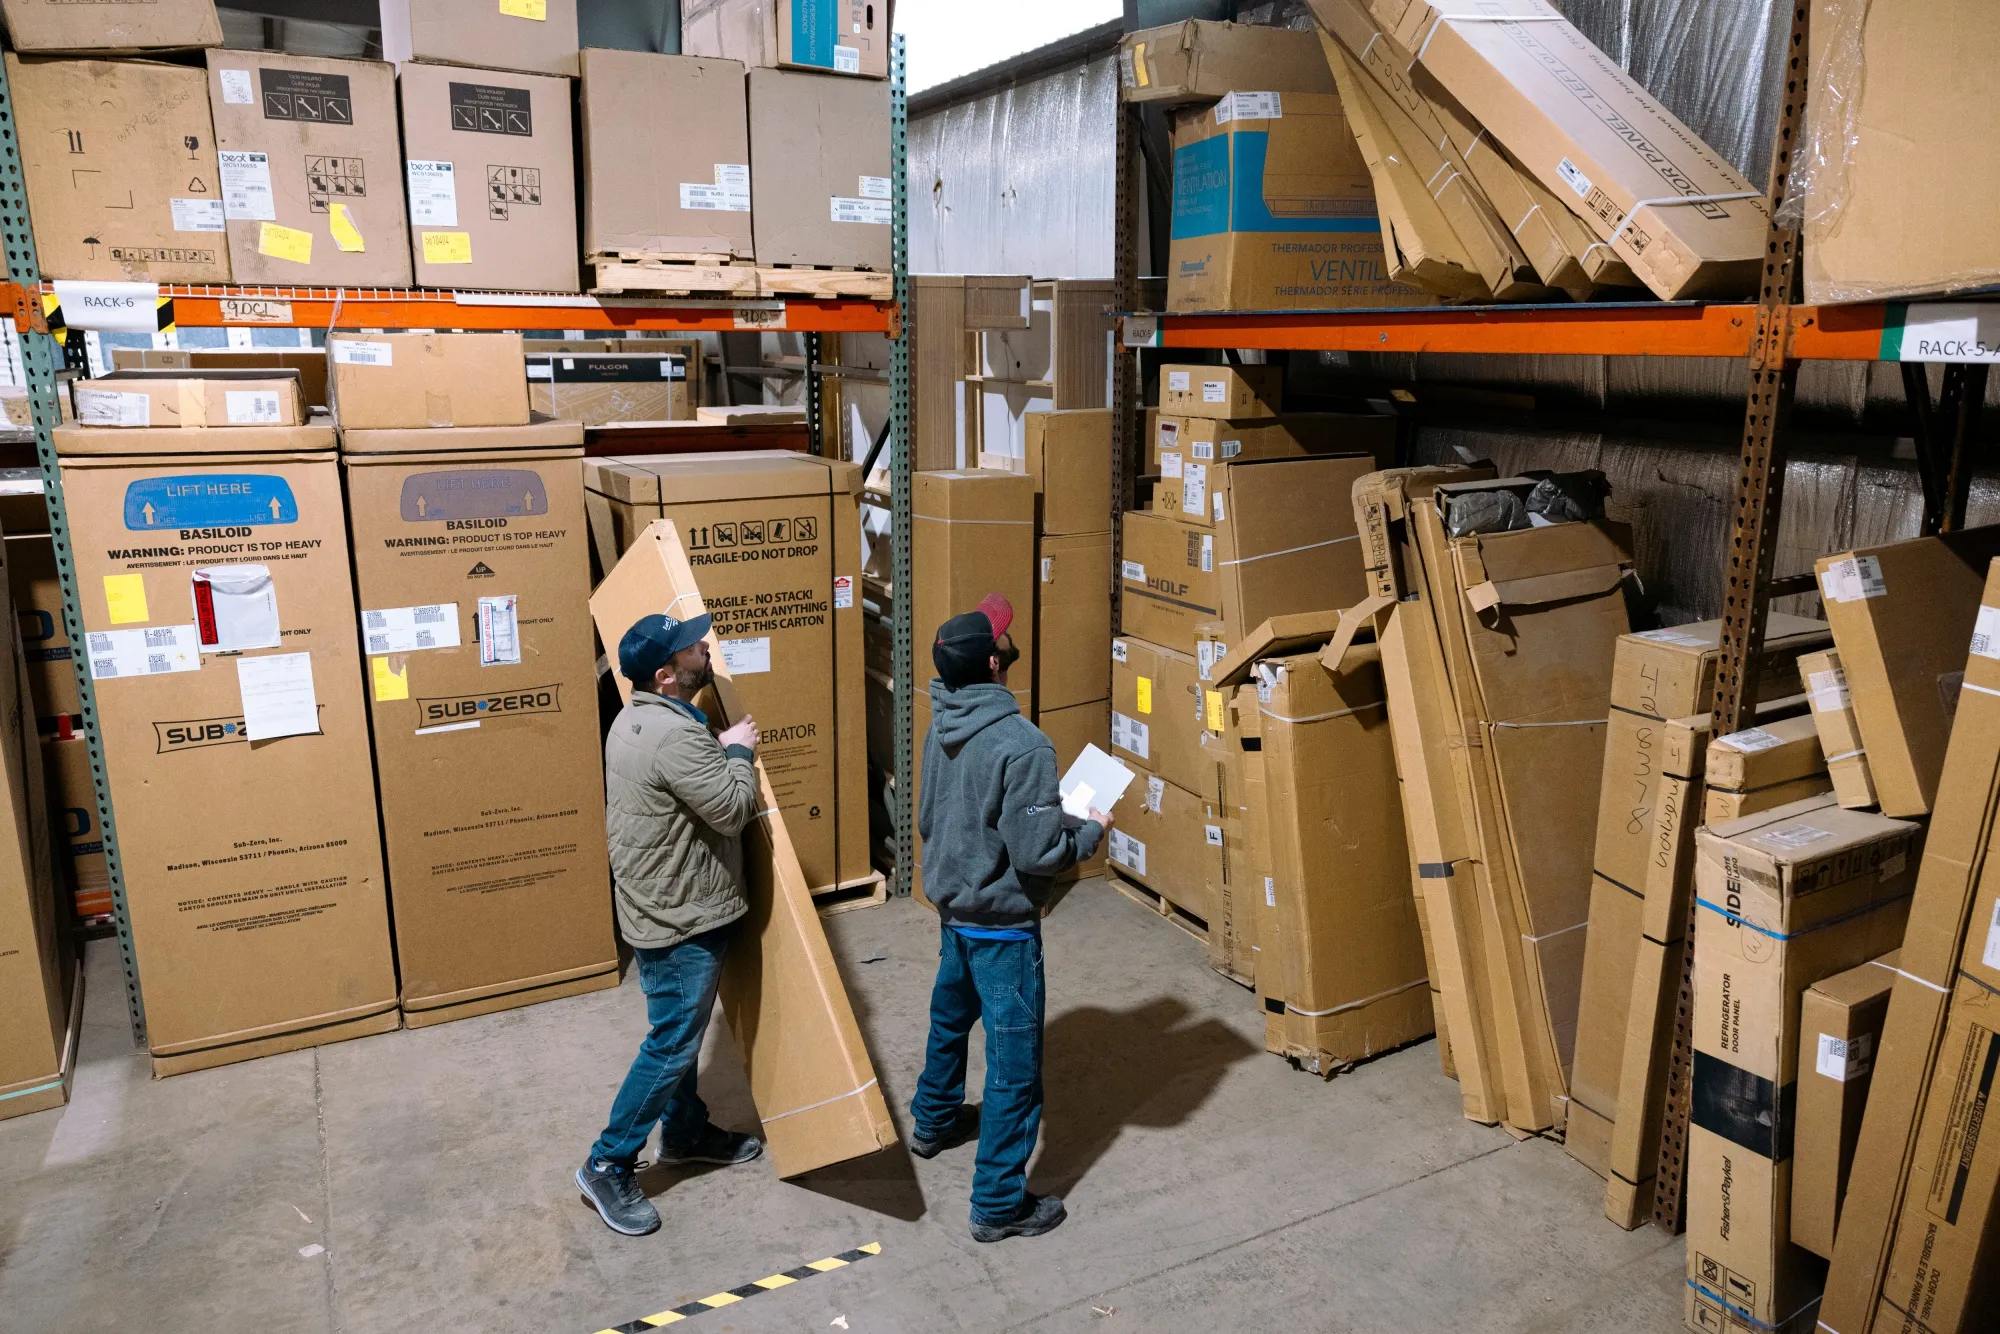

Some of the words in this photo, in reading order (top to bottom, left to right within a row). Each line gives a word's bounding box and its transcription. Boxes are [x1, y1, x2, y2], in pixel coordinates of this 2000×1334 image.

[1552, 68, 1594, 99] LEFT
[1635, 96, 1655, 114] the
[1606, 113, 1663, 163] PANEL
[1657, 115, 1702, 155] remove
[222, 153, 246, 162] best
[411, 162, 434, 171] best
[1703, 157, 1719, 170] or
[1720, 171, 1742, 191] cut
[1272, 243, 1337, 253] THERMADOR
[1341, 243, 1384, 253] PROFESS
[1310, 260, 1388, 281] VENTIL
[1274, 286, 1338, 296] THERMADOR
[84, 296, 134, 308] RACK-6
[167, 483, 200, 497] LIFT
[207, 483, 252, 495] HERE
[180, 526, 252, 541] BASILOID
[446, 518, 508, 531] BASILOID
[384, 536, 450, 548] WARNING:
[452, 533, 500, 544] PRODUCT
[502, 532, 512, 541] IS
[513, 532, 533, 540] TOP
[535, 529, 567, 539] HEAVY
[107, 546, 184, 560] WARNING:
[188, 543, 244, 556] PRODUCT
[247, 542, 258, 552] IS
[261, 541, 282, 551] TOP
[285, 539, 322, 549] HEAVY
[399, 549, 447, 557] AVERTISSEMENT
[689, 550, 759, 566] FRAGILE-DO
[761, 548, 786, 560] NOT
[787, 545, 818, 558] DROP
[126, 560, 181, 569] AVERTISSEMENT
[196, 558, 225, 566] PRODUIT
[1147, 576, 1189, 596] WOLF
[755, 594, 773, 605] NO
[774, 589, 813, 602] STACK!
[483, 605, 491, 630] ENCLOSED
[732, 607, 769, 620] STACK
[771, 601, 828, 616] ANYTHING
[293, 628, 312, 636] ONLY
[735, 623, 751, 634] OF
[752, 620, 778, 632] THIS
[779, 615, 825, 629] CARTON
[488, 692, 551, 711] ZERO
[757, 723, 816, 745] ERATOR
[480, 808, 510, 817] Sub-Zero,
[423, 828, 452, 838] Madison,
[453, 823, 484, 833] Wisconsin
[485, 820, 505, 828] 53711
[510, 815, 536, 825] Phoenix,
[536, 812, 559, 821] Arizona
[559, 808, 578, 817] 85009
[233, 838, 268, 849] Sub-Zero,
[1209, 831, 1218, 841] F
[167, 862, 201, 871] Madison,
[202, 856, 238, 866] Wisconsin
[239, 852, 262, 861] 53711
[267, 846, 298, 857] Phoenix,
[299, 843, 325, 852] Arizona
[325, 839, 348, 848] 85009
[539, 848, 577, 858] INSTALLATION
[431, 862, 456, 870] NOTICE:
[456, 857, 486, 866] CONTENTS
[1732, 857, 1740, 879] LADO
[177, 897, 206, 907] NOTICE:
[207, 893, 241, 902] CONTENTS
[243, 888, 265, 896] HEAVY
[275, 883, 300, 892] HANDLE
[320, 876, 348, 884] CAUTION
[178, 904, 206, 912] CARTON
[206, 899, 233, 908] SHOULD
[233, 895, 259, 904] REMAIN
[285, 887, 304, 896] UNTIL
[304, 881, 348, 893] INSTALLATION
[1726, 879, 1741, 929] SIDE
[1721, 973, 1731, 1050] REFRIGERATOR
[1732, 1027, 1740, 1053] DOOR
[1960, 1100, 1986, 1170] AVERTISSEMENT
[1720, 1155, 1734, 1241] Fisher&Paykel
[1915, 1269, 1926, 1284] DE
[1928, 1269, 1941, 1296] DOOR
[1904, 1282, 1923, 1326] PANNEAX
[1920, 1295, 1936, 1321] PANEL
